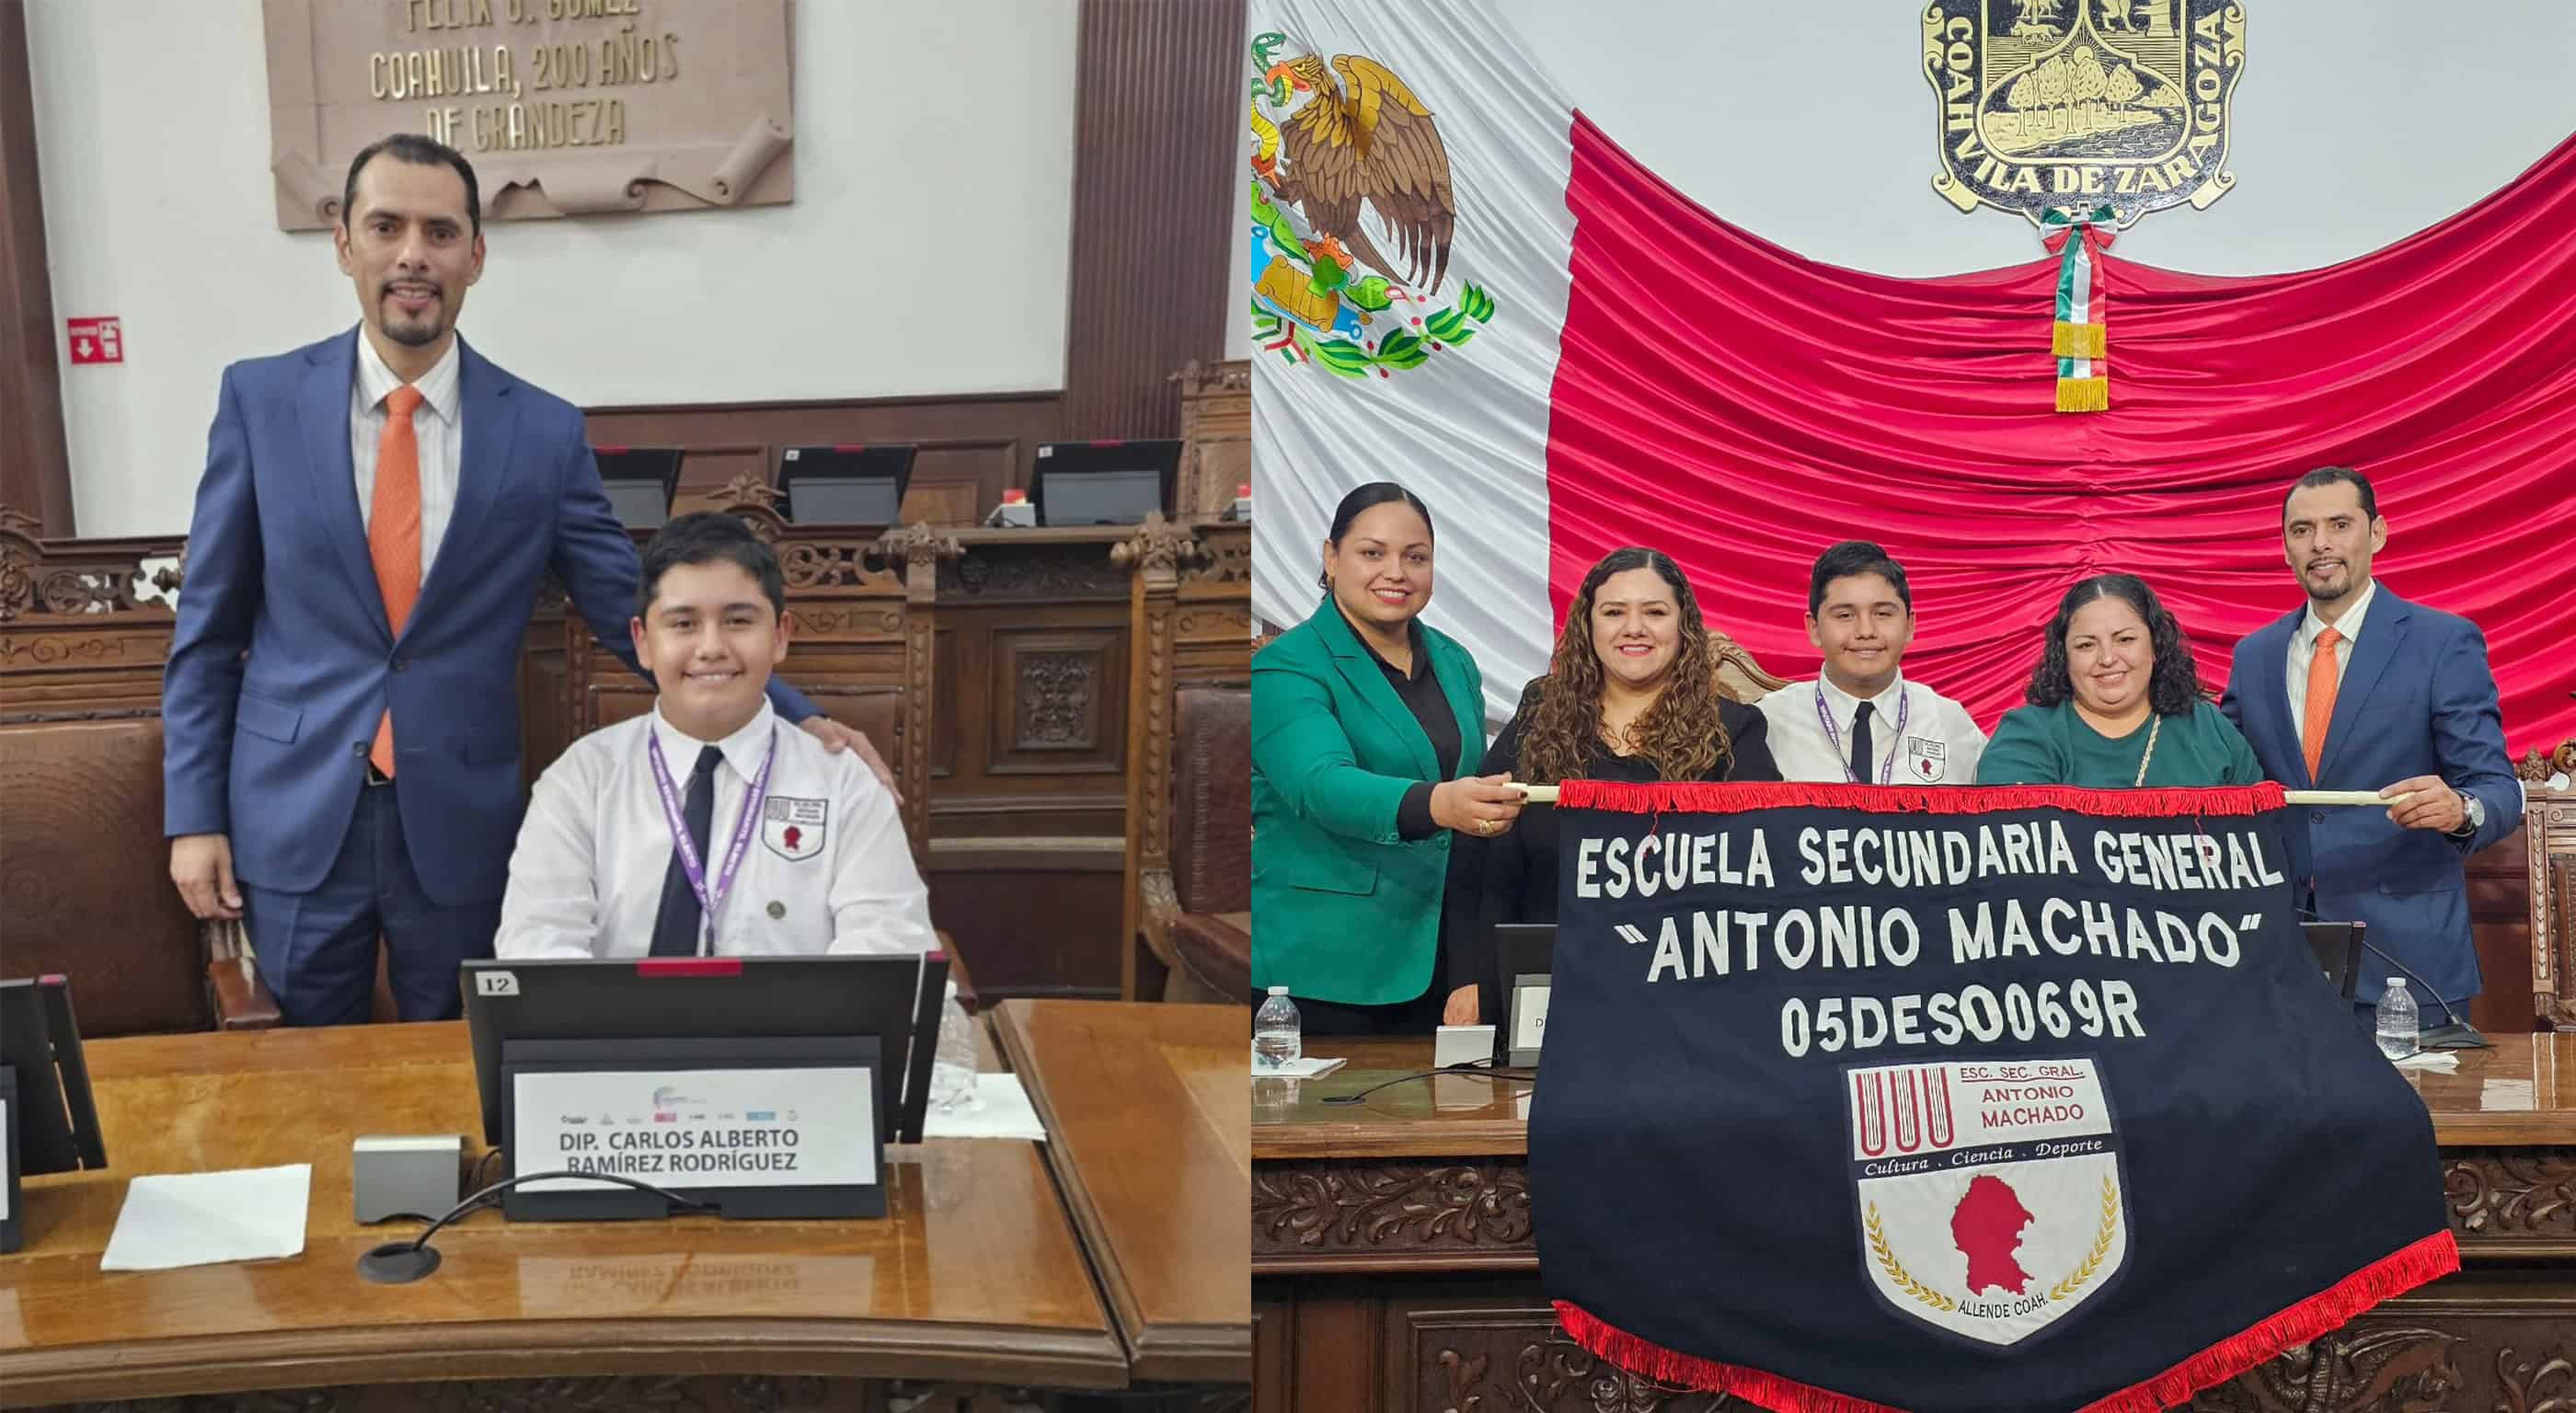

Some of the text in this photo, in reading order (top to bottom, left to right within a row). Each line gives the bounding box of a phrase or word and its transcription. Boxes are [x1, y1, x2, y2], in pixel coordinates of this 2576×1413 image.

[370, 24, 680, 100] COAHUILA, 200 AÑOS
[2053, 167, 2106, 193] DE
[2115, 7, 2224, 193] ZARAGOZA
[472, 99, 627, 153] GRANDEZA
[1576, 820, 2285, 899] ESCUELA SECUNDARIA GENERAL
[485, 977, 510, 993] 12
[1960, 1065, 2085, 1080] ESC. SEC. GRAL.
[1981, 1086, 2075, 1104] ANTONIO
[1981, 1103, 2085, 1130] MACHADO
[559, 1129, 799, 1152] DIP. CARLOS ALBERTO
[567, 1149, 799, 1174] RAMÍREZ RODRÍGUEZ
[1864, 1138, 2103, 1177] Cultura Ciencia Deporte
[1958, 1291, 2049, 1319] ALLENDE COAH.
